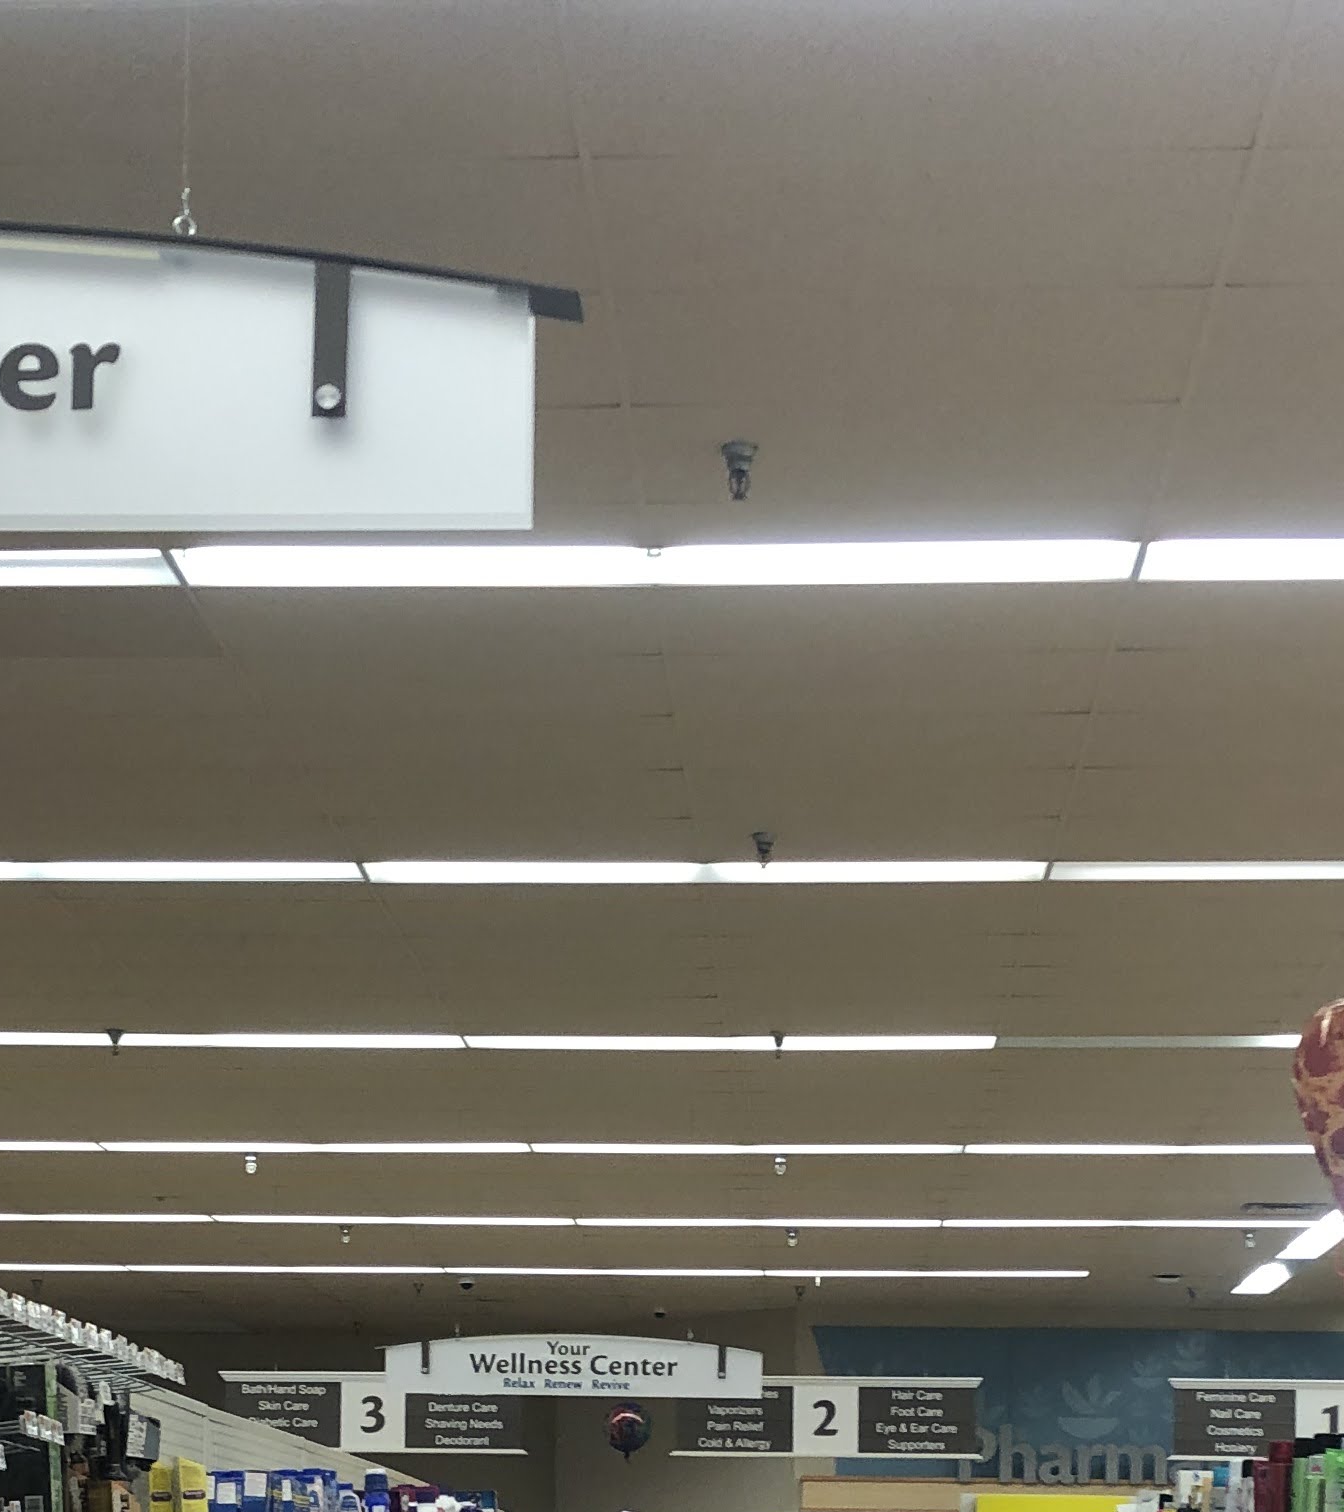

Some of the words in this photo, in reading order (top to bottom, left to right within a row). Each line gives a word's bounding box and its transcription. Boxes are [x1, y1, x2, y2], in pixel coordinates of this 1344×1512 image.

[547, 1341, 591, 1357] Your
[469, 1353, 582, 1376] Wellness
[590, 1355, 678, 1377] Center
[503, 1378, 535, 1389] Relax
[544, 1379, 582, 1390] Renew
[591, 1379, 630, 1390] Revive
[298, 1384, 326, 1397] Soap
[891, 1390, 915, 1400] Hair
[917, 1390, 943, 1400] Care
[1196, 1391, 1246, 1402] Feminine
[1248, 1392, 1276, 1403] Care
[258, 1400, 280, 1411] Skin
[283, 1400, 309, 1411] Care
[428, 1402, 469, 1413] Denture
[471, 1402, 498, 1413] Care
[708, 1405, 763, 1417] Vaporizers
[360, 1395, 386, 1433] 3
[813, 1400, 839, 1436] 2
[890, 1407, 914, 1417] Foot
[917, 1407, 943, 1417] Care
[1210, 1409, 1232, 1419] Nail
[1234, 1409, 1261, 1419] Care
[292, 1417, 318, 1428] Care
[425, 1418, 468, 1431] Shaving
[469, 1418, 503, 1430] Needs
[1321, 1405, 1339, 1434] 1
[707, 1420, 731, 1431] Pain
[733, 1421, 763, 1432] Relief
[876, 1423, 897, 1435] Eye
[899, 1423, 908, 1433] &
[910, 1423, 930, 1433] Ear
[931, 1423, 958, 1434] Care
[1206, 1425, 1264, 1437] Cosmetics
[435, 1435, 490, 1446] Deodorant
[698, 1437, 723, 1448] Cold
[725, 1438, 734, 1448] &
[735, 1438, 772, 1450] Allergy
[888, 1440, 946, 1451] Supporters
